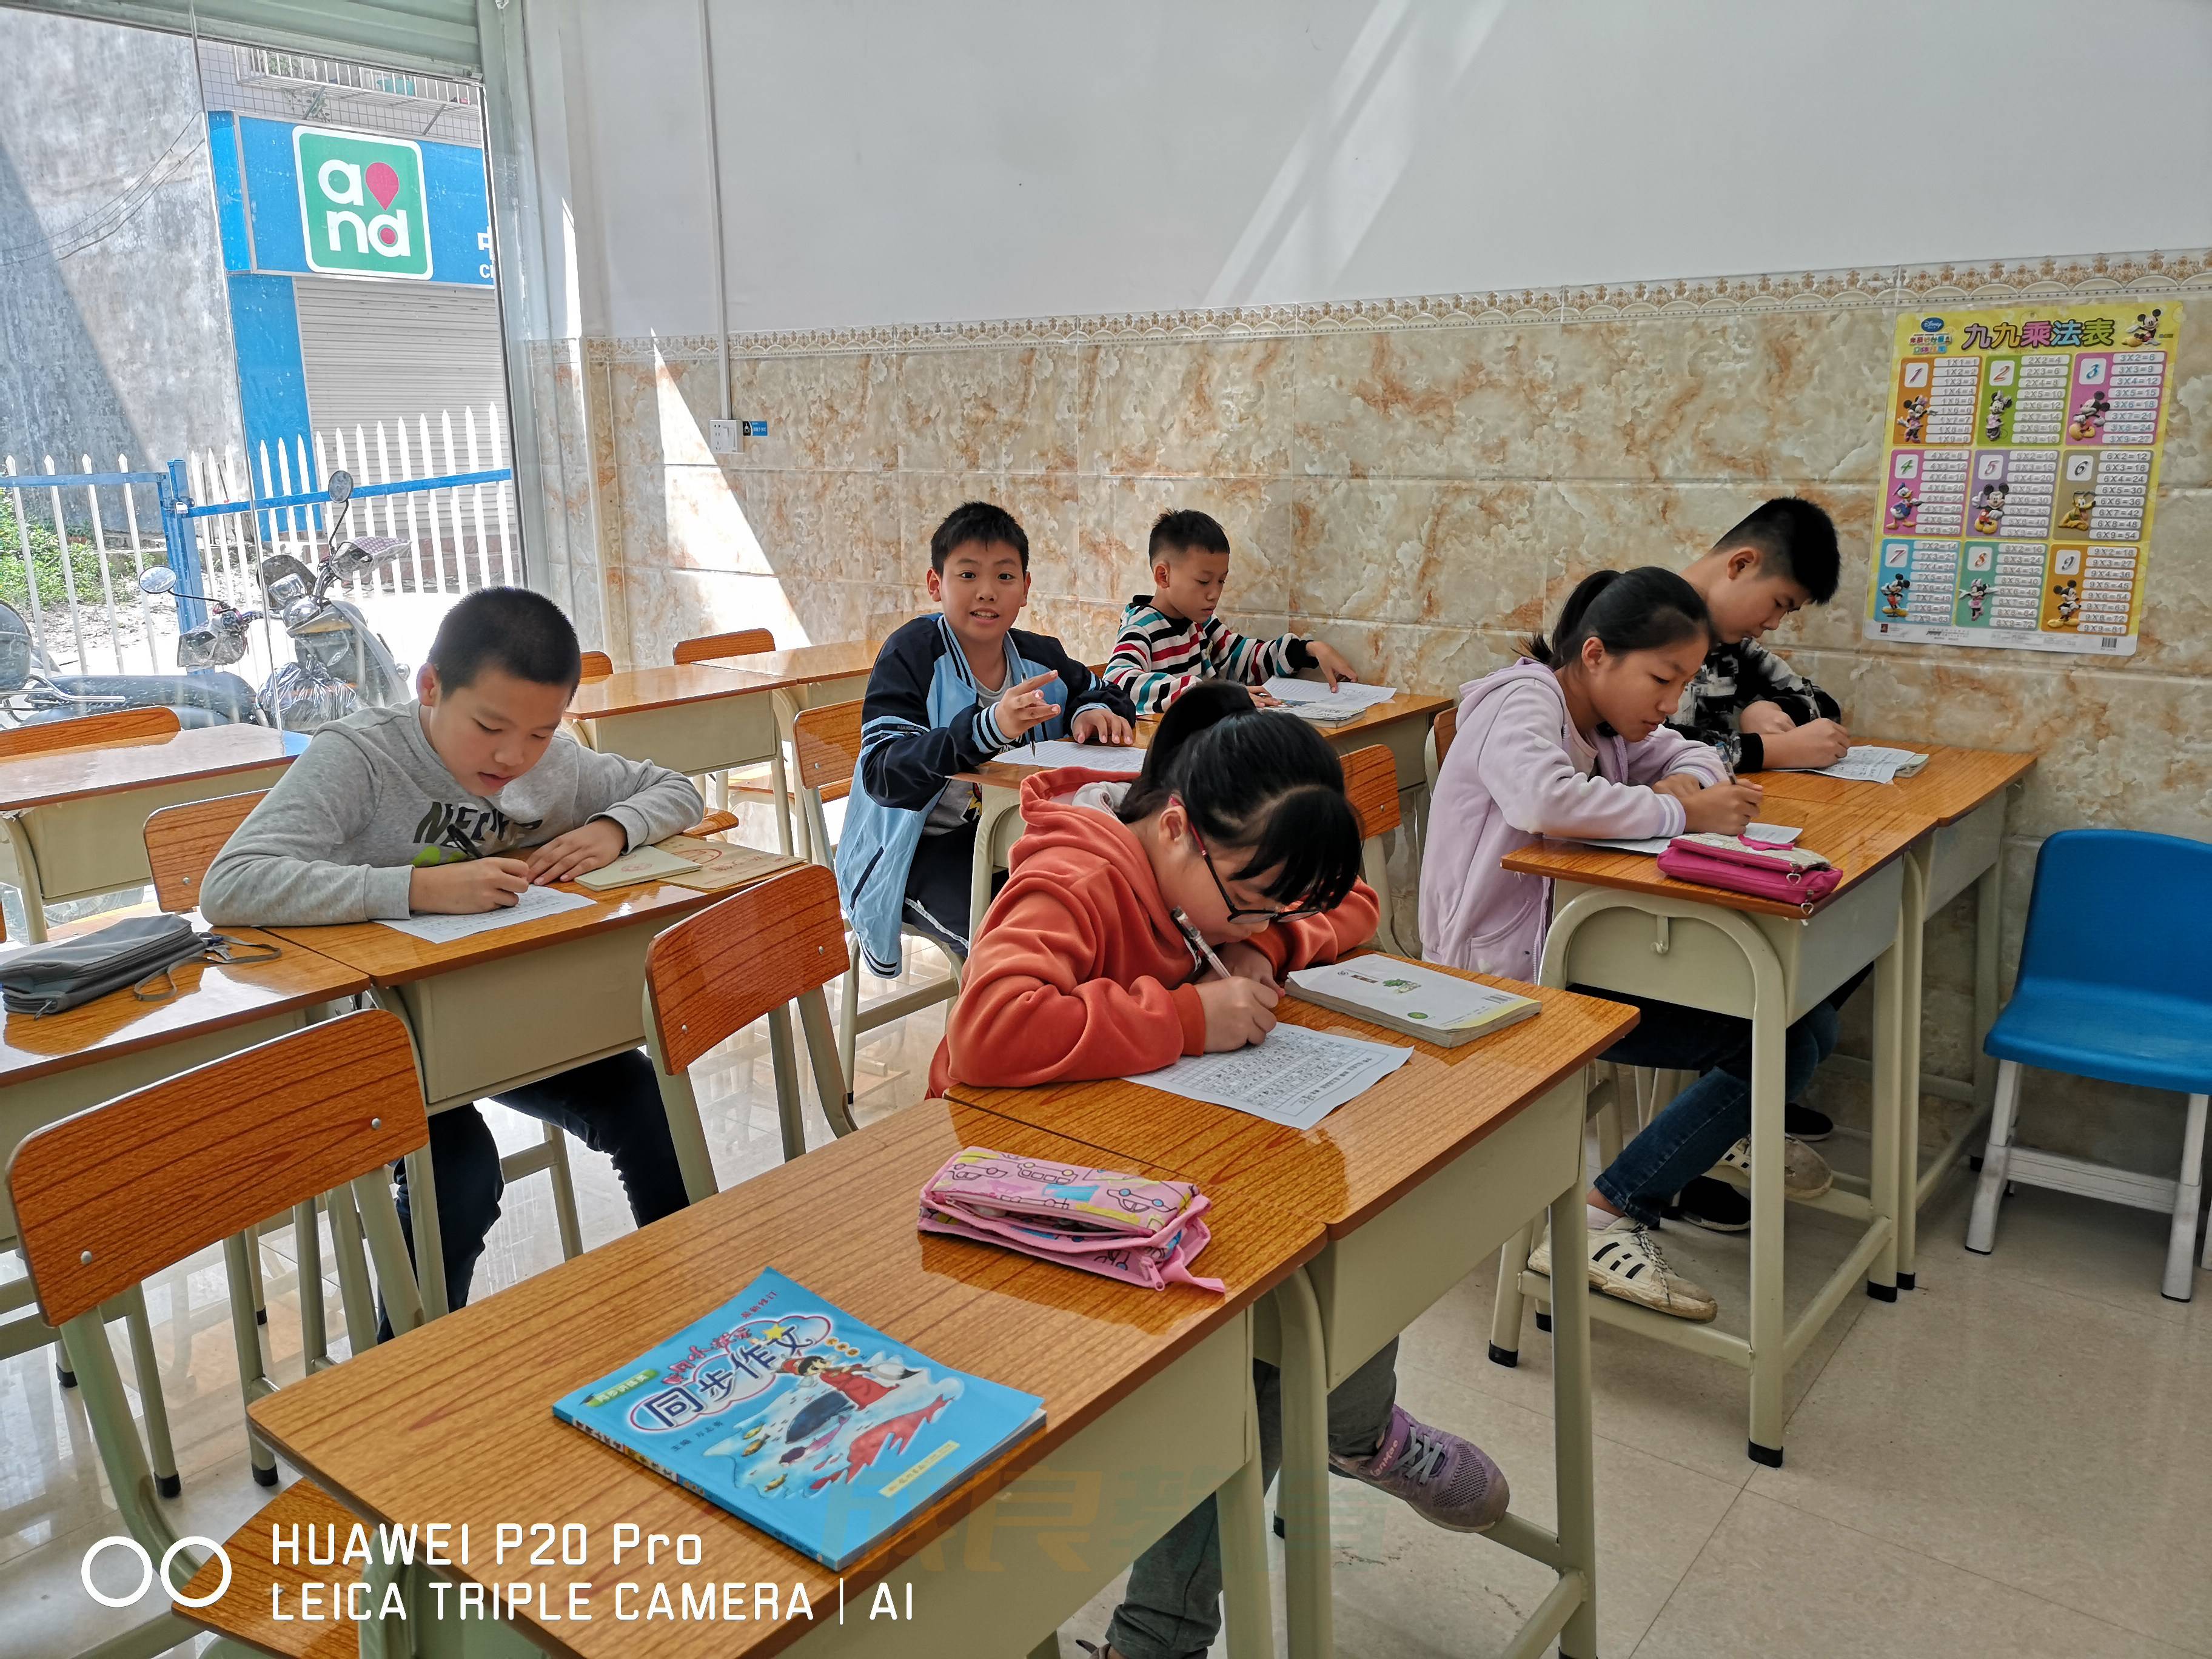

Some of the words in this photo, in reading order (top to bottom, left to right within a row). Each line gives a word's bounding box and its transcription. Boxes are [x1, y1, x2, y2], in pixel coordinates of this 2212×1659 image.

[1962, 318, 2115, 350] 九九乘法表
[1910, 368, 1923, 383] 1
[1993, 366, 2009, 382] 2
[2086, 364, 2100, 380] 3
[1901, 460, 1912, 475] 4
[1985, 460, 2000, 476] 5
[2074, 461, 2088, 476] 6
[1890, 550, 1906, 563] 7
[1976, 553, 1986, 567] 8
[2062, 556, 2074, 571] 9
[643, 1325, 814, 1428] 同步作文
